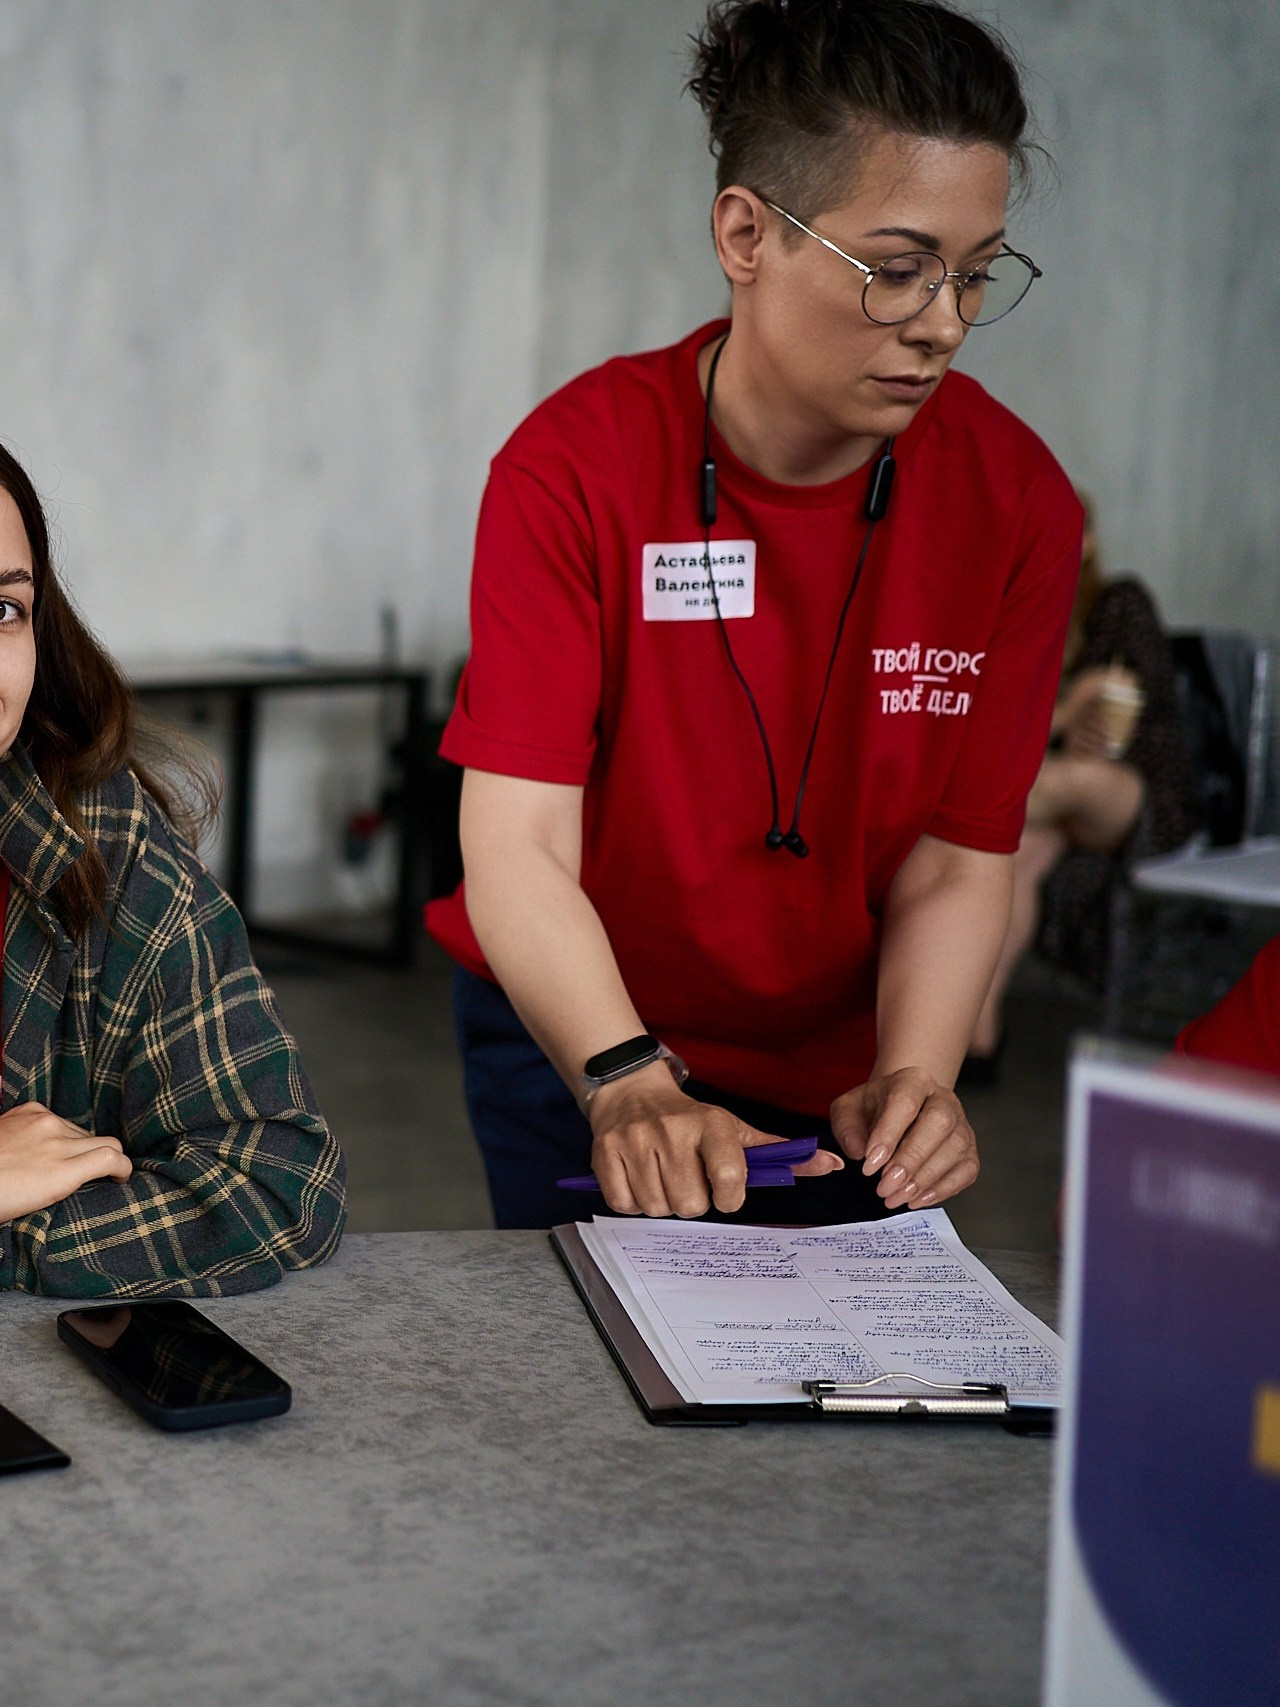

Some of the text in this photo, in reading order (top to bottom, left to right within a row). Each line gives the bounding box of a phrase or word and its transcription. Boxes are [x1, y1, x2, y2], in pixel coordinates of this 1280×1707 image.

[872, 641, 920, 673] ТВОЙ
[880, 683, 973, 717] ТВОЁ ДЕЛ
